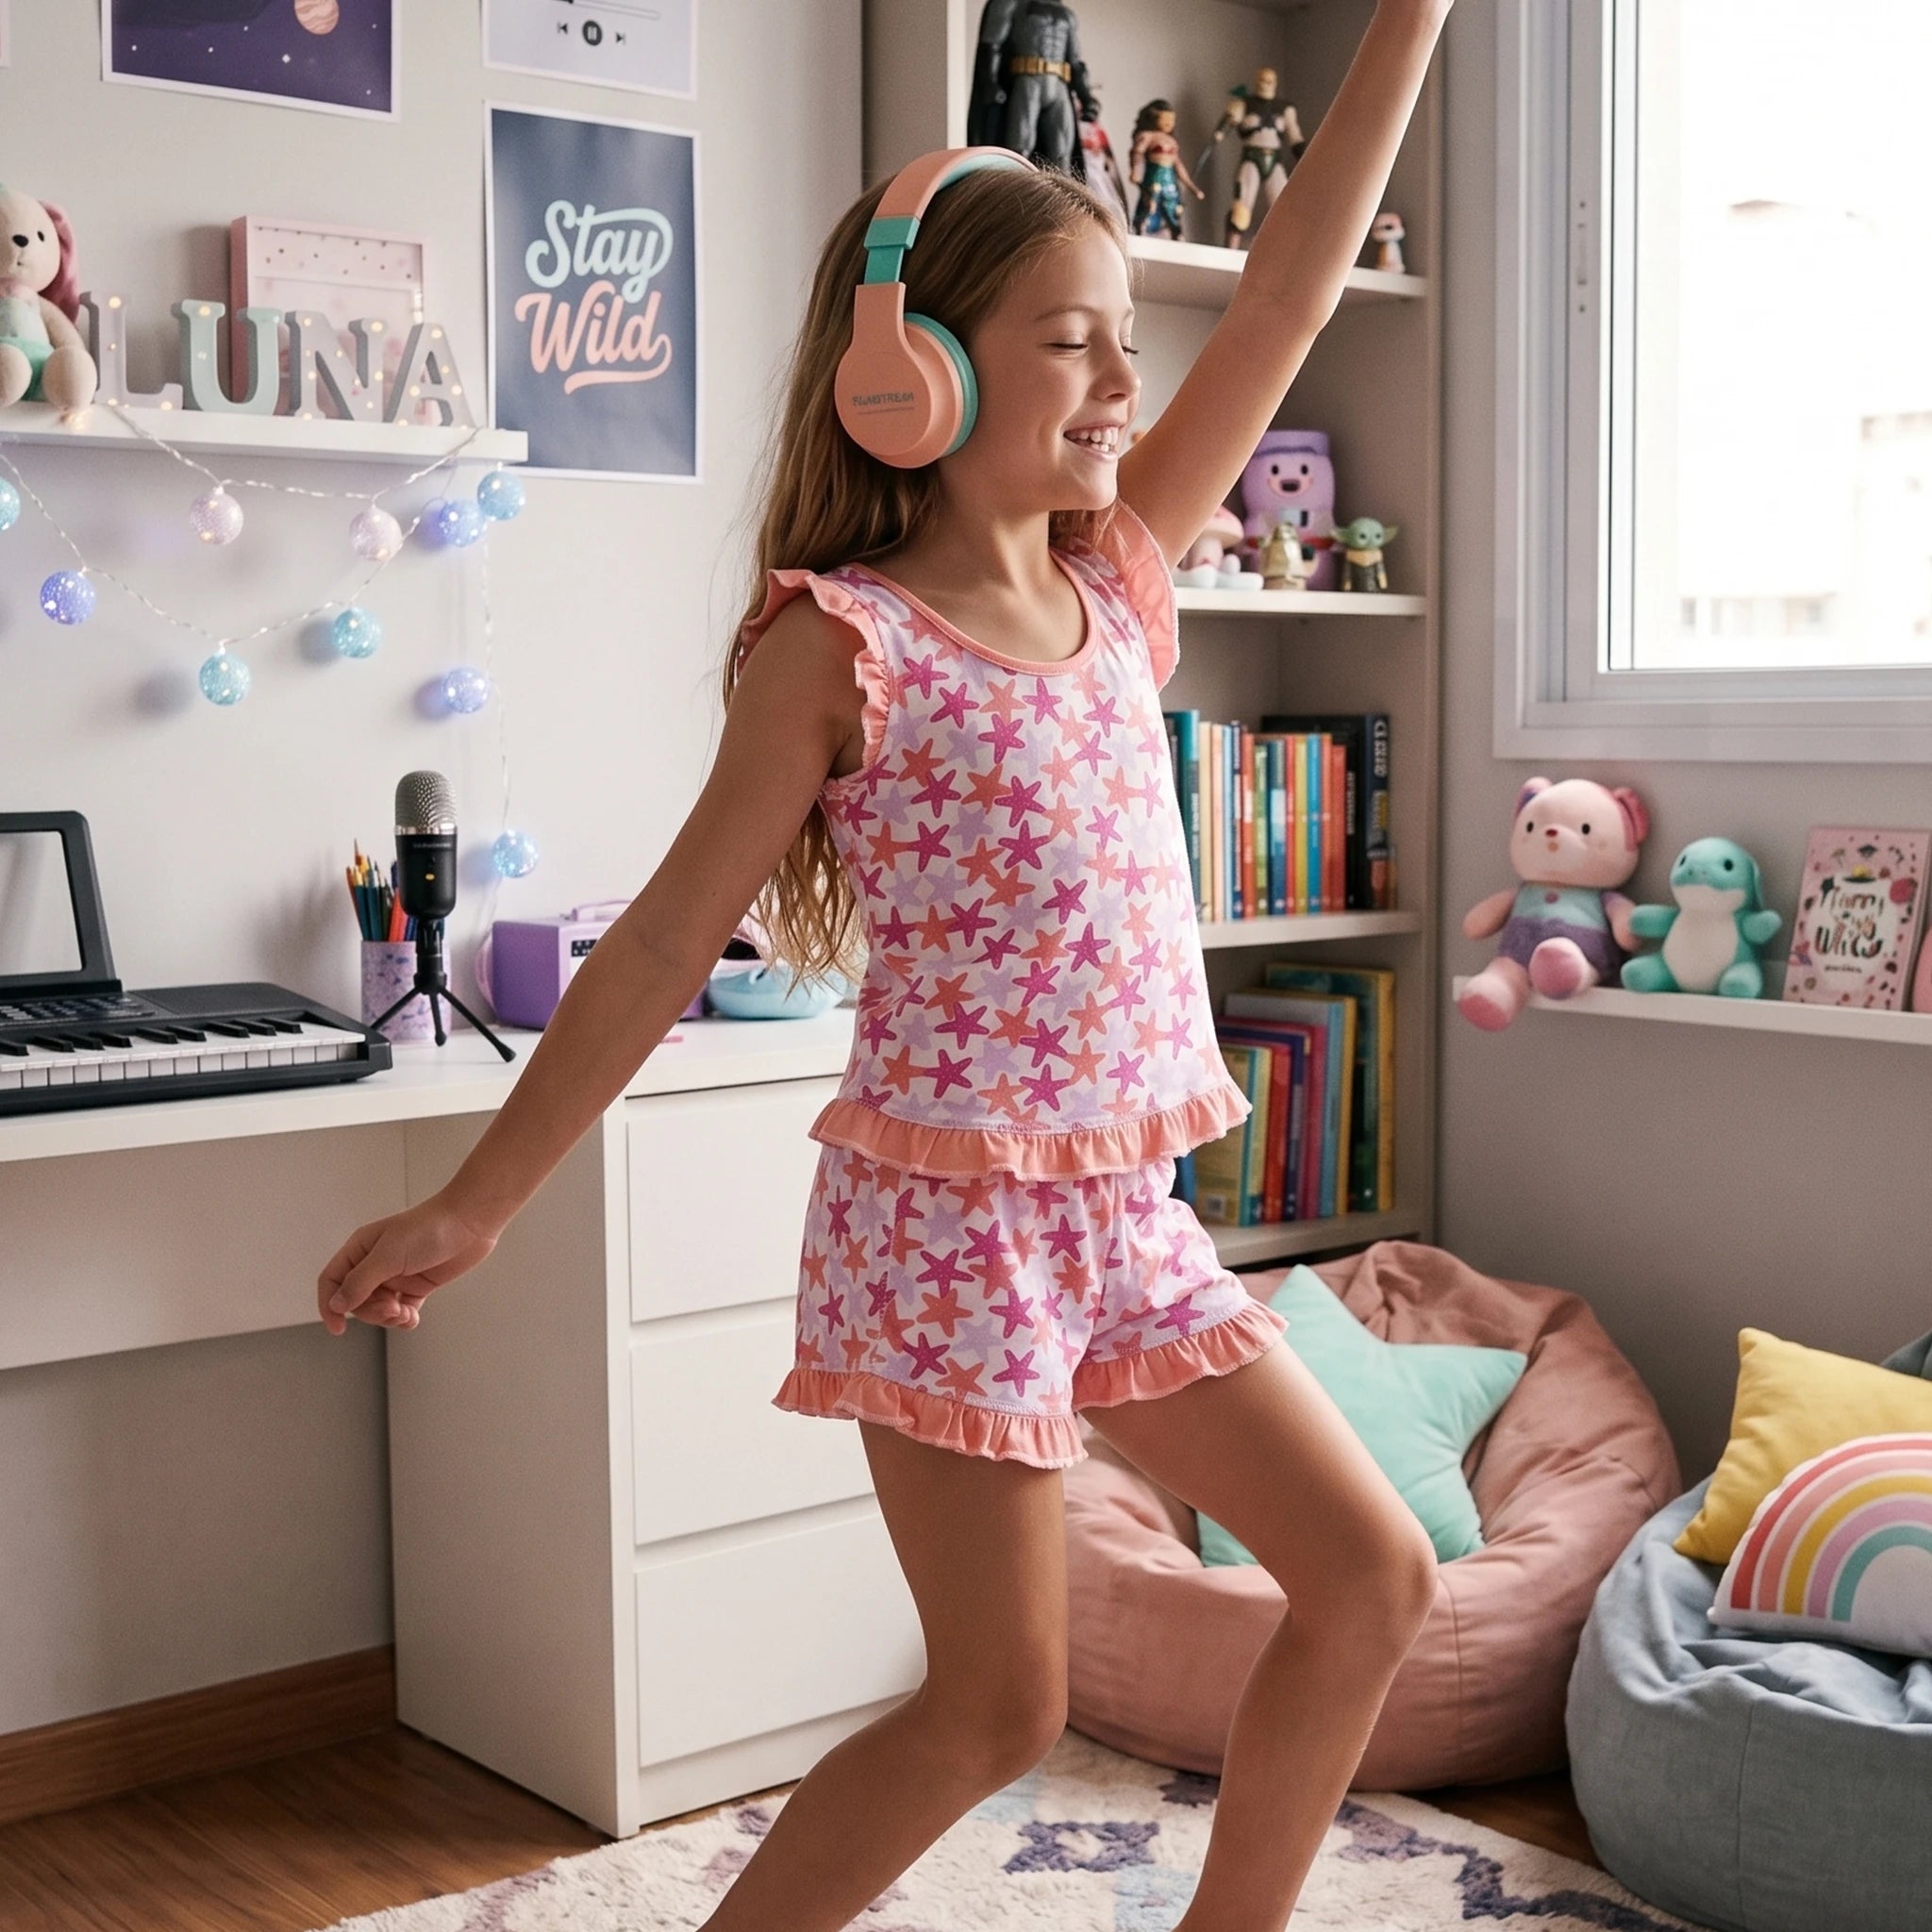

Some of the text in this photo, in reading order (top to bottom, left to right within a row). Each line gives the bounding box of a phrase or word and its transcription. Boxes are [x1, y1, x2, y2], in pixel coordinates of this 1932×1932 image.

[525, 200, 673, 303] Stay
[80, 291, 478, 428] LUNA
[514, 280, 672, 394] Wild
